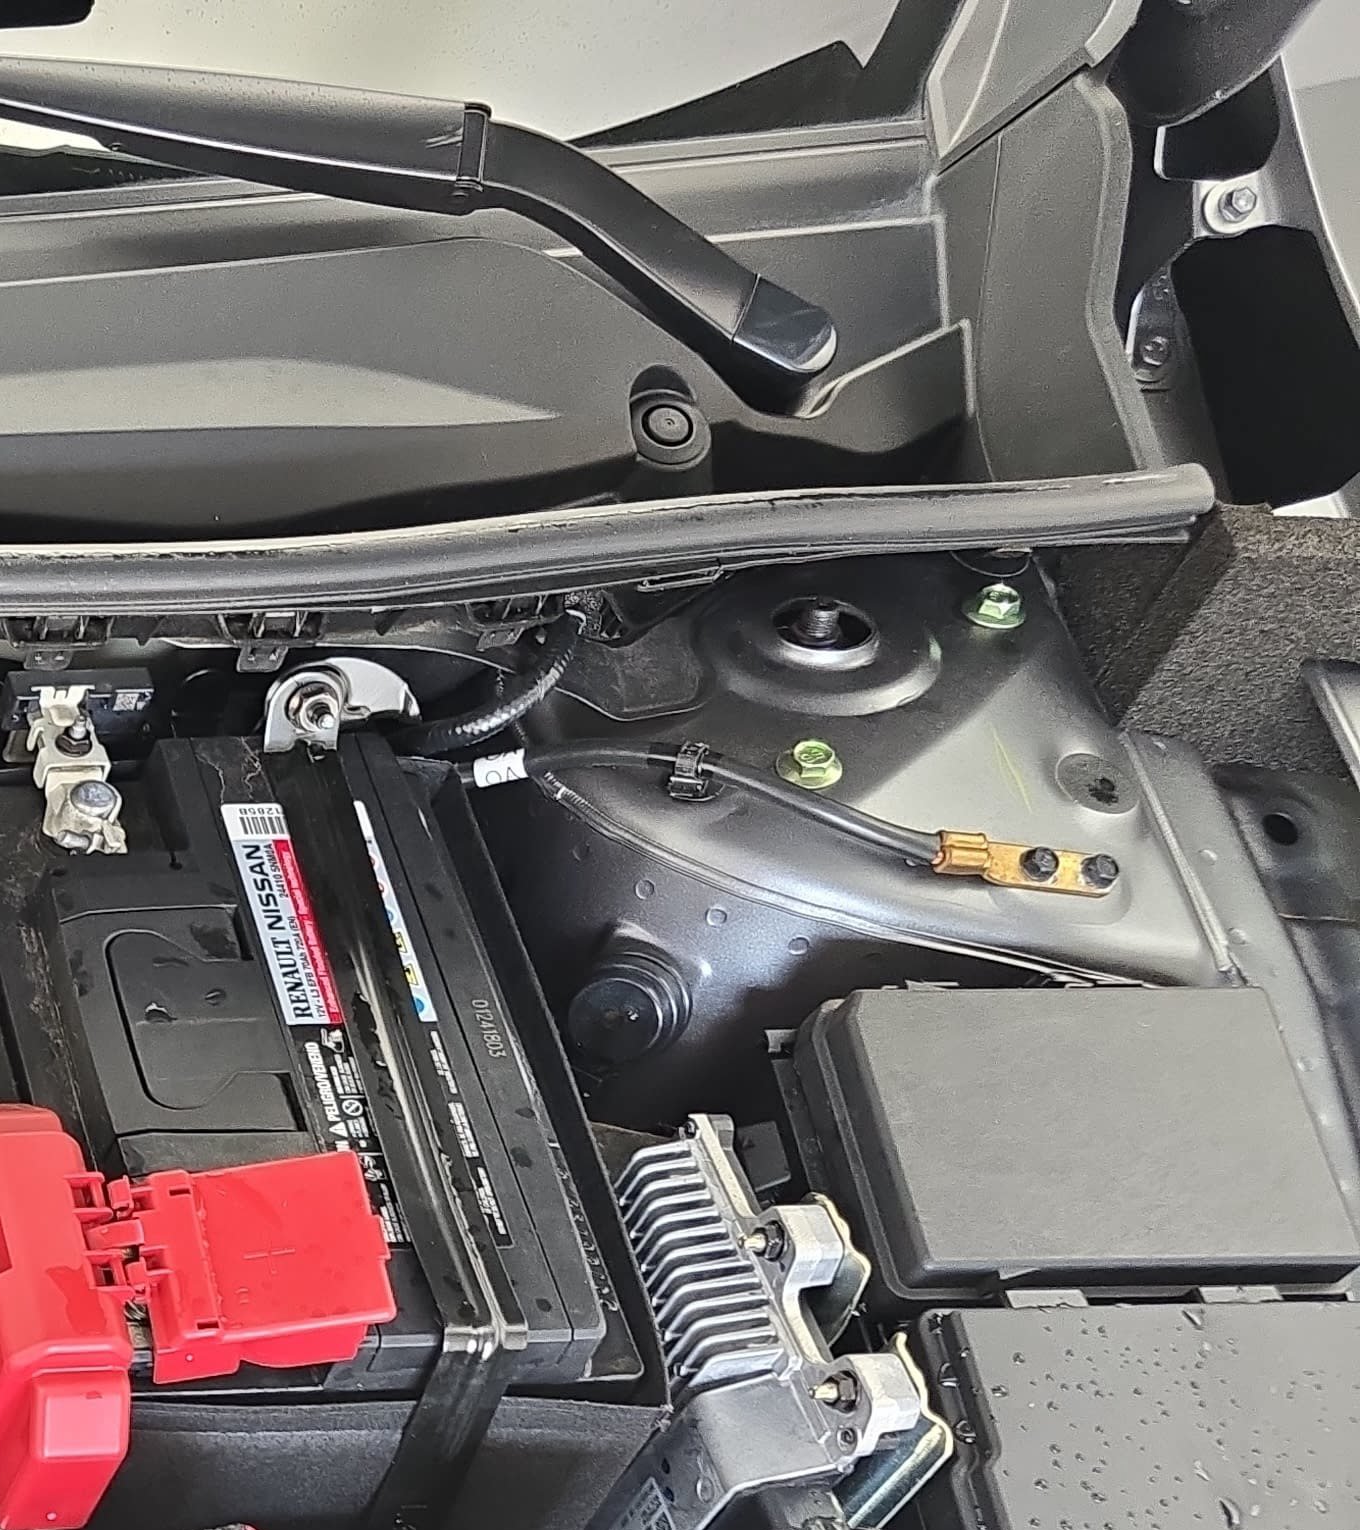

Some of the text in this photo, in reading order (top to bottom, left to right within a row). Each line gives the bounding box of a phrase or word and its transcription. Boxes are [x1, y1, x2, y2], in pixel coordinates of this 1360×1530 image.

[241, 844, 313, 1019] RENAULT NISSAN
[471, 1000, 507, 1057] 01241803
